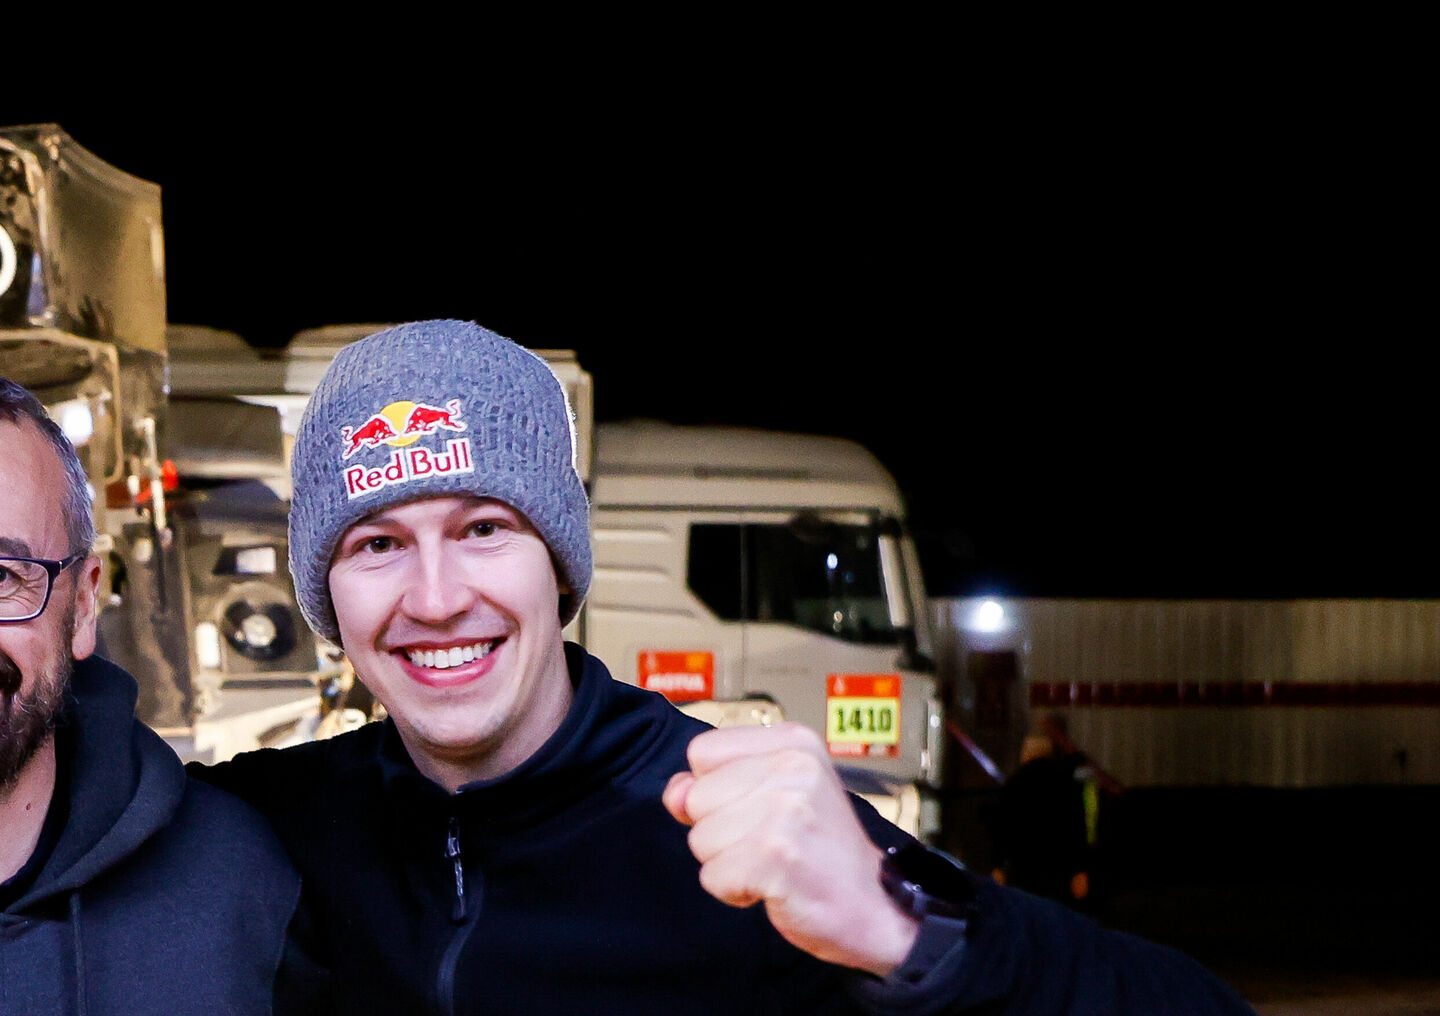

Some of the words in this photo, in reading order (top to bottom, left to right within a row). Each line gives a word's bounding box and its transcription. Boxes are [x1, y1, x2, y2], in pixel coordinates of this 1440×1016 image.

[347, 452, 404, 495] Red
[409, 441, 470, 476] Bull
[836, 707, 892, 733] 1410
